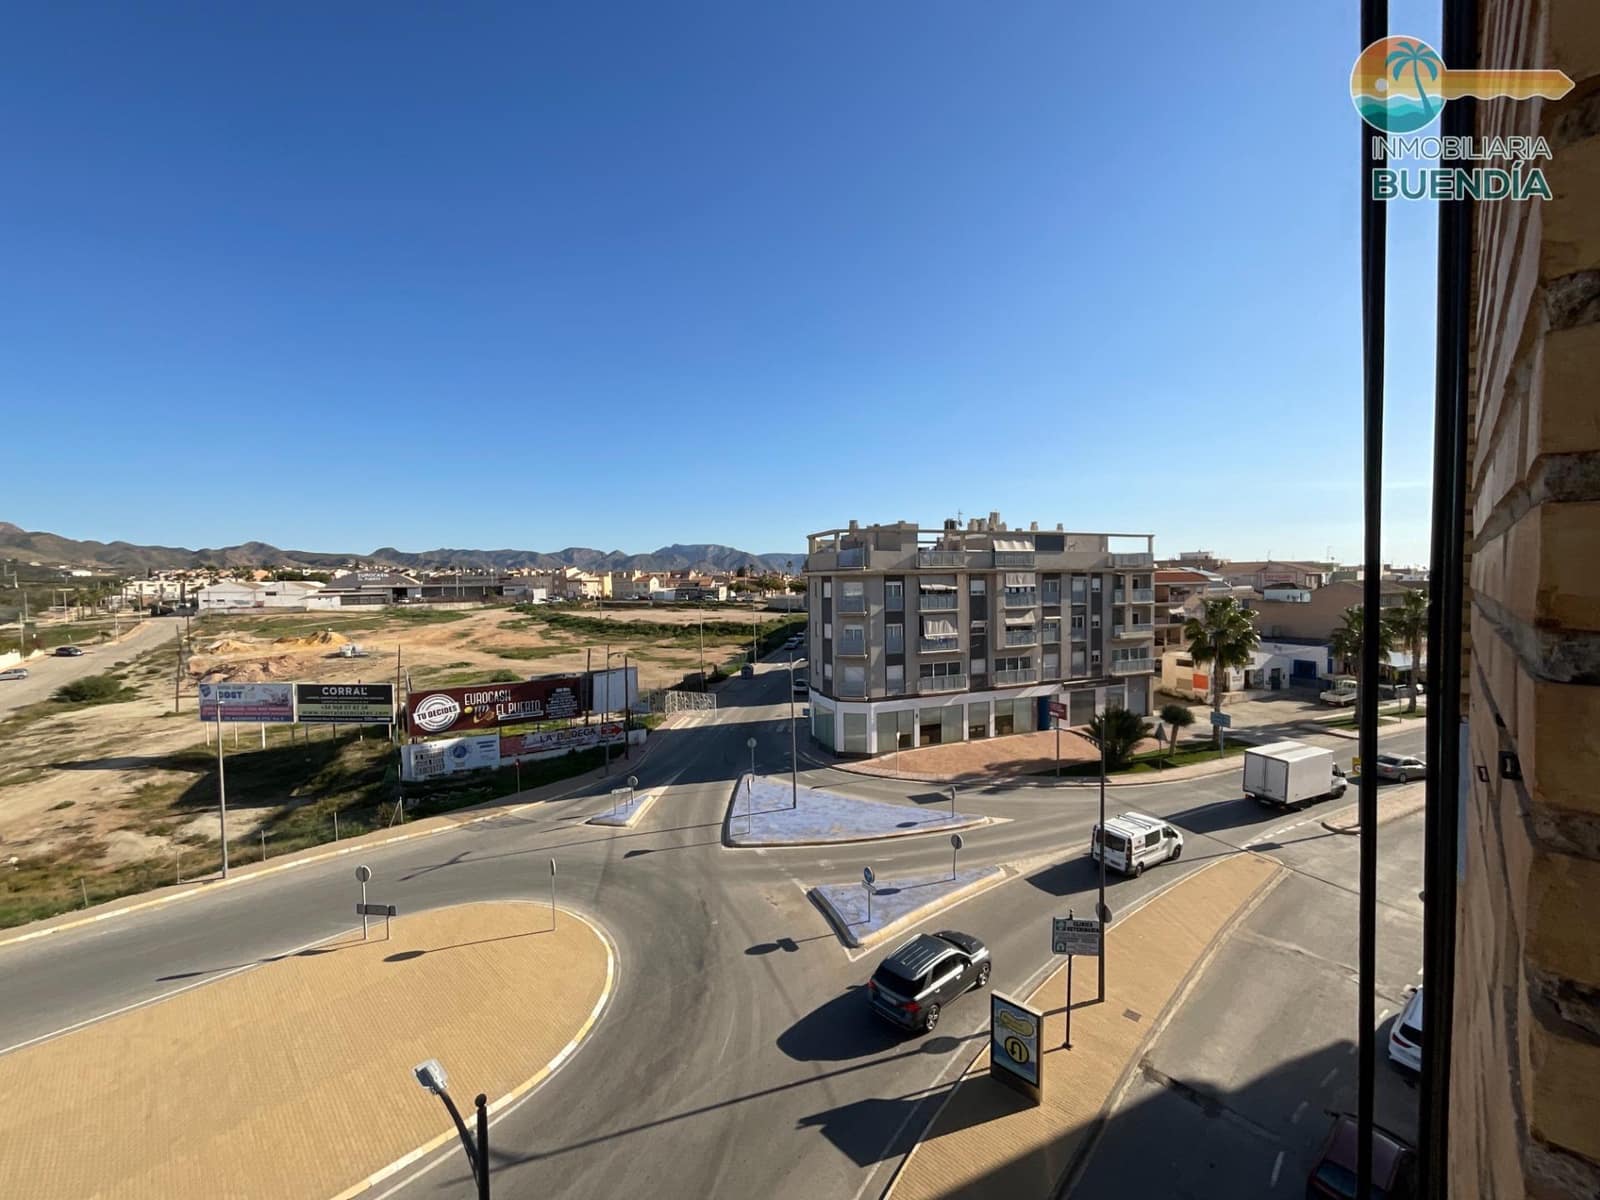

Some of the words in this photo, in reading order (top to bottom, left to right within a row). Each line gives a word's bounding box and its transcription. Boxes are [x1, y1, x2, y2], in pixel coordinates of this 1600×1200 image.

[321, 686, 368, 695] CORRAL
[464, 690, 512, 706] EUROCASH
[415, 712, 427, 722] TU
[428, 705, 458, 719] DECIDES
[496, 703, 508, 716] EL
[557, 728, 597, 740] BDEGA
